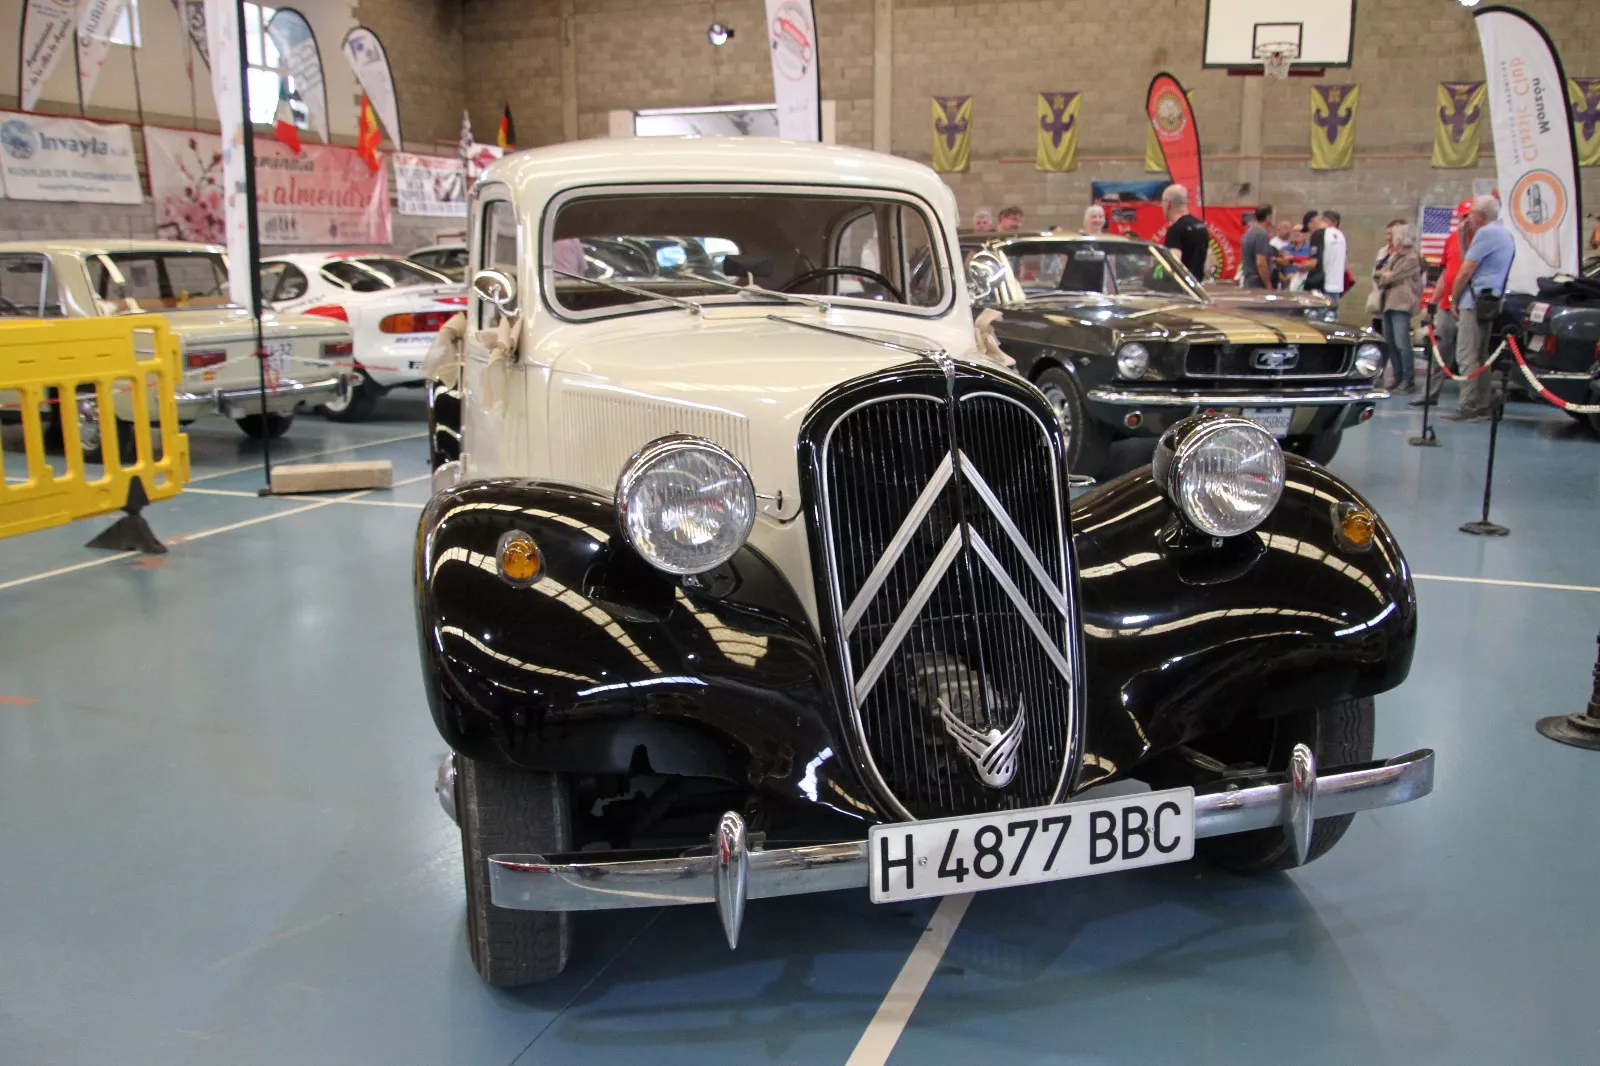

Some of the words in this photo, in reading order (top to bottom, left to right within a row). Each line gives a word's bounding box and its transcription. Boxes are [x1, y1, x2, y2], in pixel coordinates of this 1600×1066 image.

[39, 132, 108, 158] Invayla
[880, 834, 914, 892] H
[937, 814, 1073, 883] 4877
[1090, 801, 1181, 865] BBC
